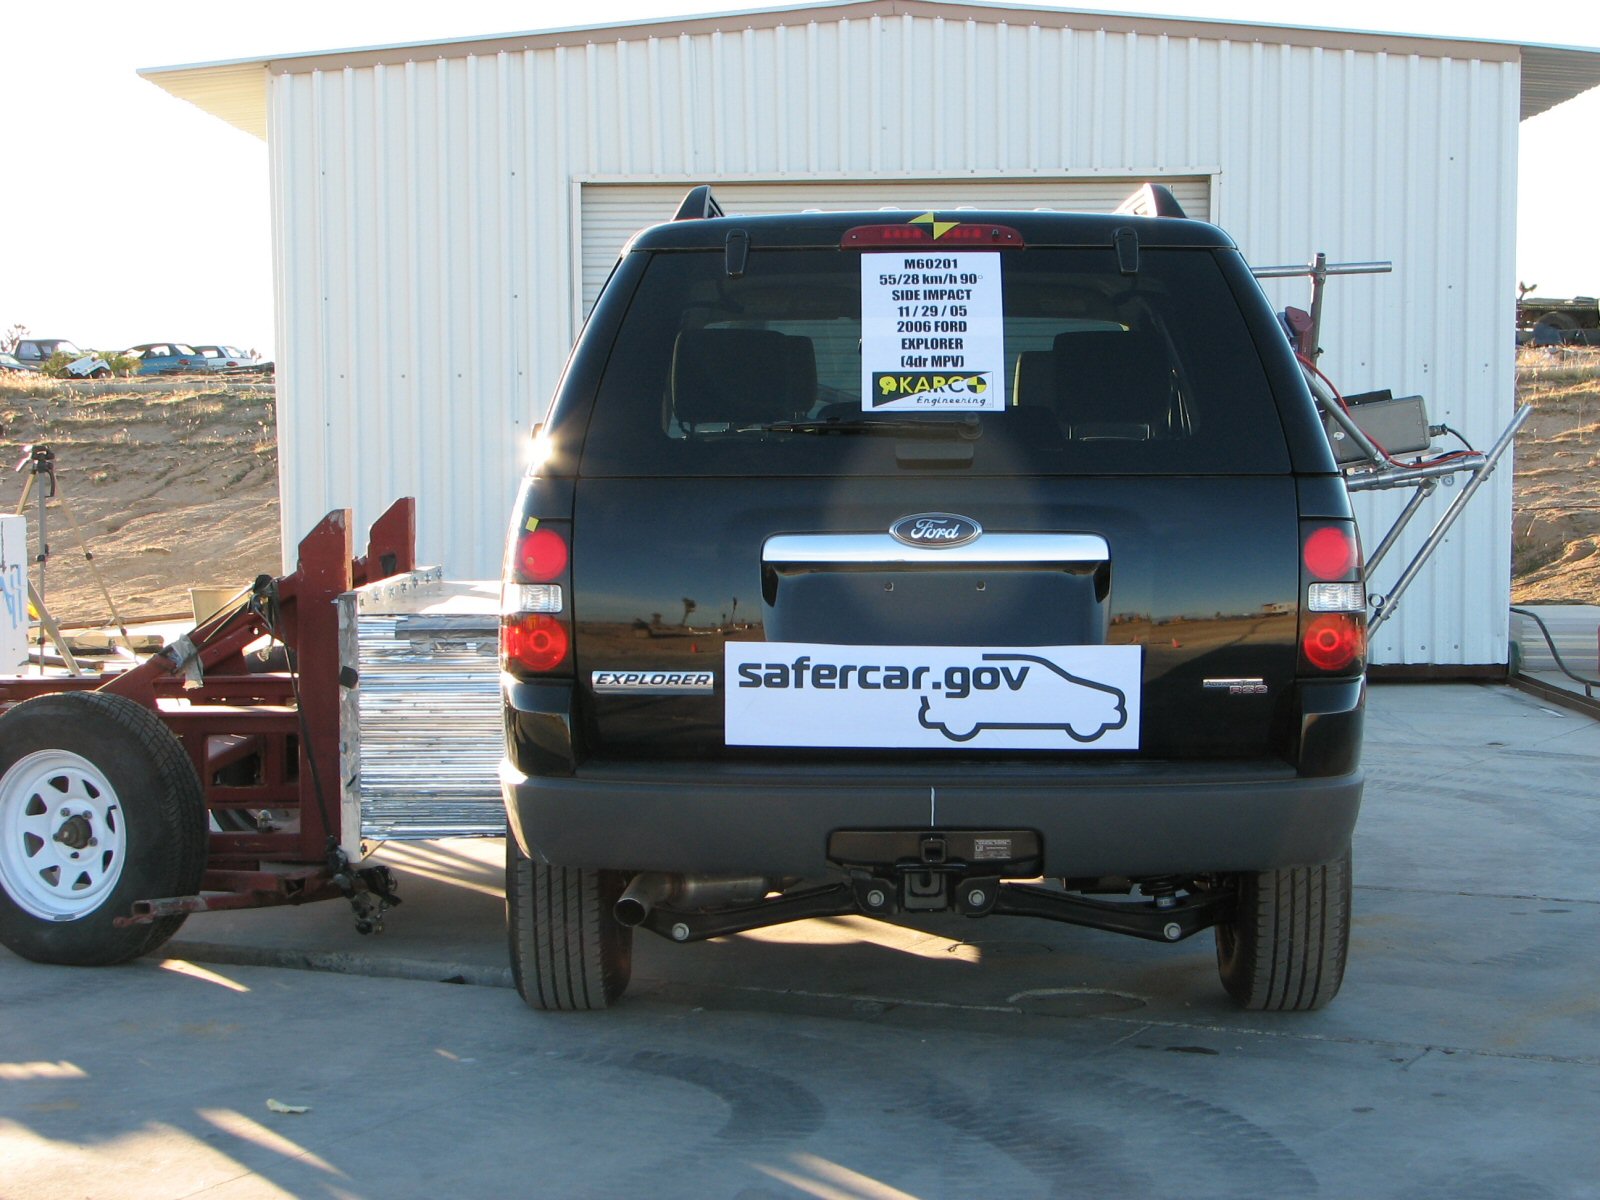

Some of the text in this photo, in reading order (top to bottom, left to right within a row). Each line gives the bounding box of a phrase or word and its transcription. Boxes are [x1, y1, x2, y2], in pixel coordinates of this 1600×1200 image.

[904, 258, 958, 270] M60201
[879, 274, 920, 285] 55/28
[922, 273, 957, 285] km/h
[892, 289, 972, 301] SIDE IMPACT
[897, 320, 967, 333] 2006 FORD
[901, 337, 964, 350] EXPLORER
[901, 355, 964, 368] (4dr MPV)
[916, 396, 986, 407] Engineering
[910, 518, 960, 540] Ford
[595, 673, 711, 686] EXPLORER
[738, 656, 1030, 698] safercar.gov
